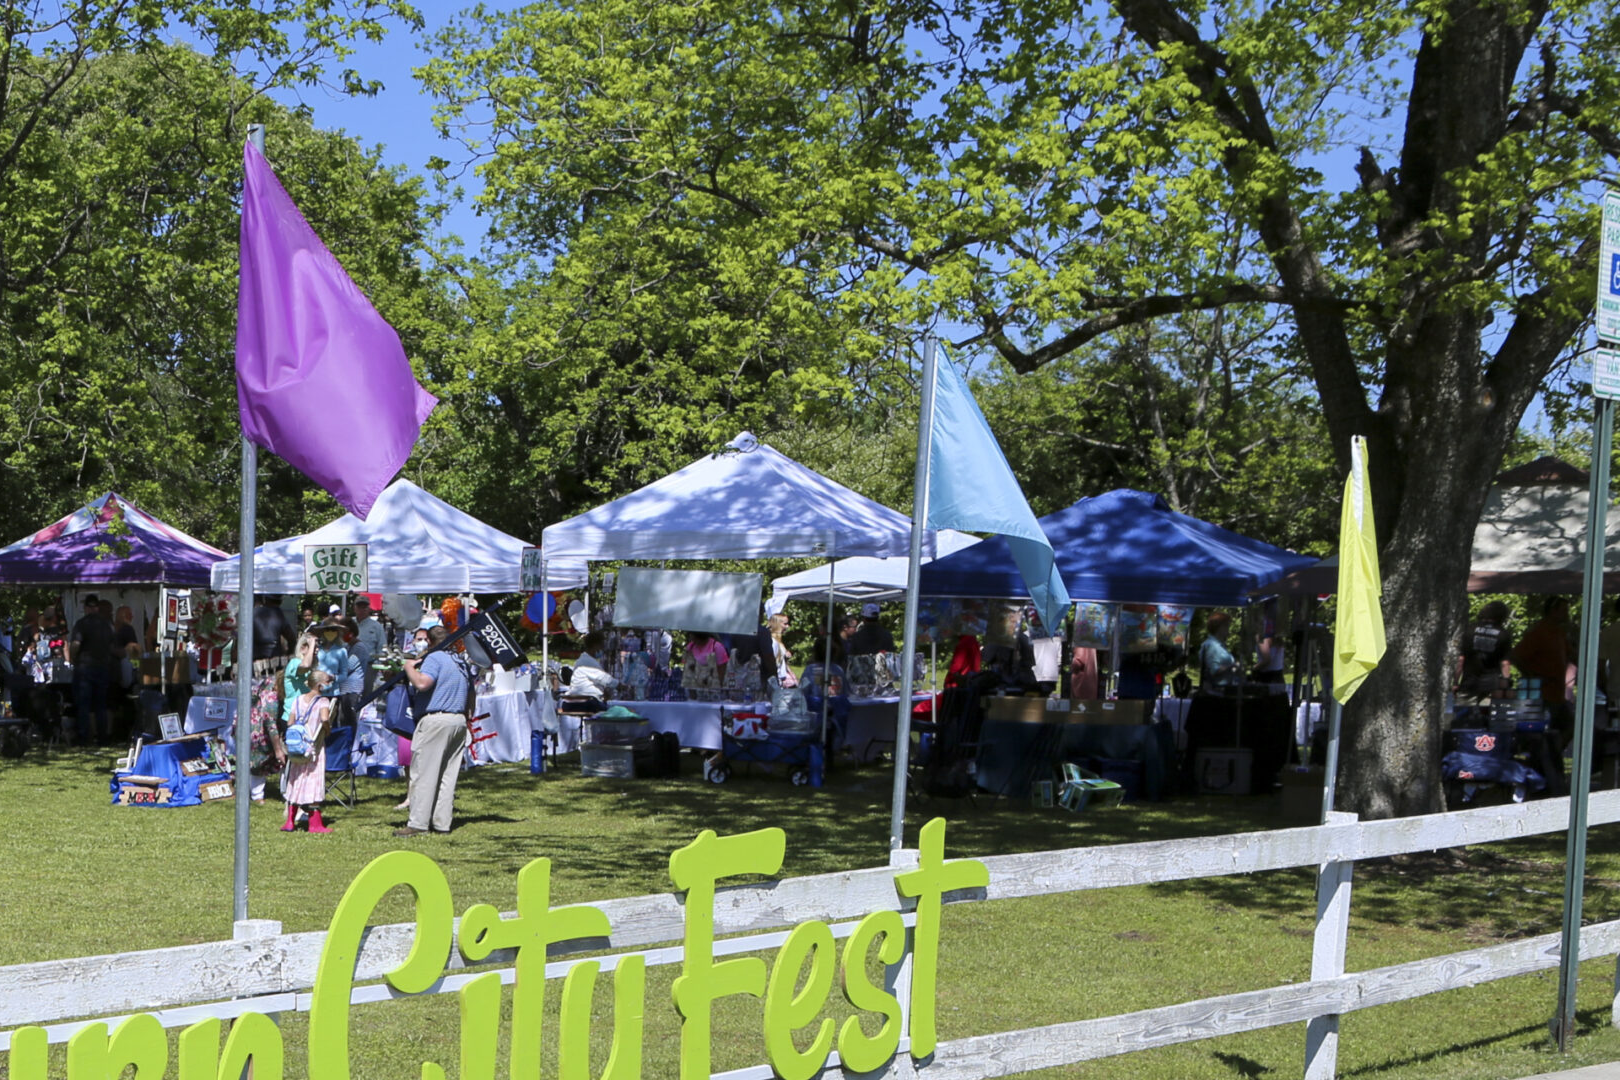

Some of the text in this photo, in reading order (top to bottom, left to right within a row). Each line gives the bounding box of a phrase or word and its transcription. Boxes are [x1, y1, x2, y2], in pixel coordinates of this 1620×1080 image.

[312, 547, 358, 568] Gift
[310, 569, 362, 590] Tags
[481, 625, 508, 654] 2207
[128, 791, 160, 803] MERRY
